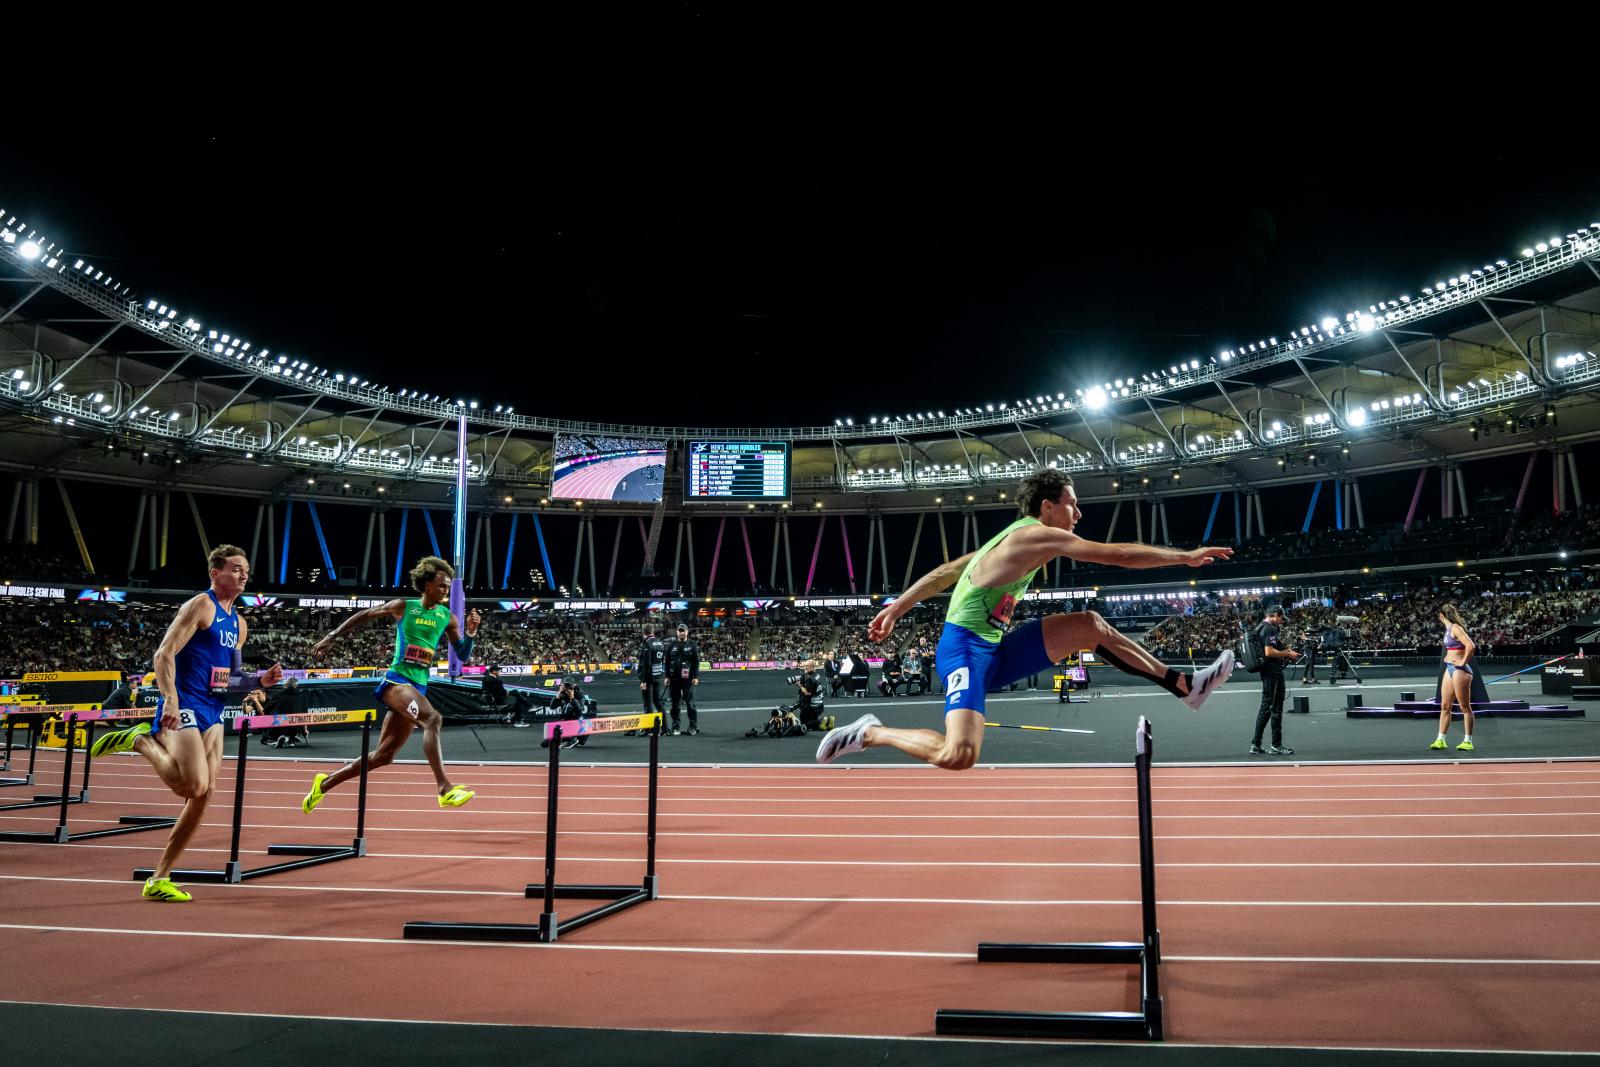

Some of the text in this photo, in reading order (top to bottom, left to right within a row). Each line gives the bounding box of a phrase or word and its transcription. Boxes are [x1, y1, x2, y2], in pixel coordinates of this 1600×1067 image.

[8, 586, 34, 597] HURDLES
[34, 587, 49, 598] SEMI
[49, 588, 65, 599] FINAL
[1085, 590, 1097, 598] FINAL
[299, 598, 316, 607] MEN'S
[316, 598, 333, 607] 400M
[333, 599, 357, 608] HURDLES
[357, 600, 371, 608] SEMI
[554, 601, 636, 610] MEN'S 400M HURDLES SEMI FINAL
[794, 599, 809, 607] MEN'S
[809, 599, 824, 607] 400M
[846, 598, 858, 606] SEMI
[858, 598, 871, 606] FINAL
[415, 617, 437, 627] BRASIL
[220, 630, 238, 649] USA
[500, 666, 526, 674] ONY
[26, 673, 59, 681] SEIKO
[951, 672, 963, 690] 2
[18, 704, 75, 713] ULTIMATE CHAMPIONSHIP
[116, 709, 139, 718] ULTIMATE
[180, 712, 192, 724] 8
[288, 713, 348, 725] ULTIMATE CHAMPIONSHIP
[591, 717, 641, 732] ULTIMATE CHAMPIONSHIP
